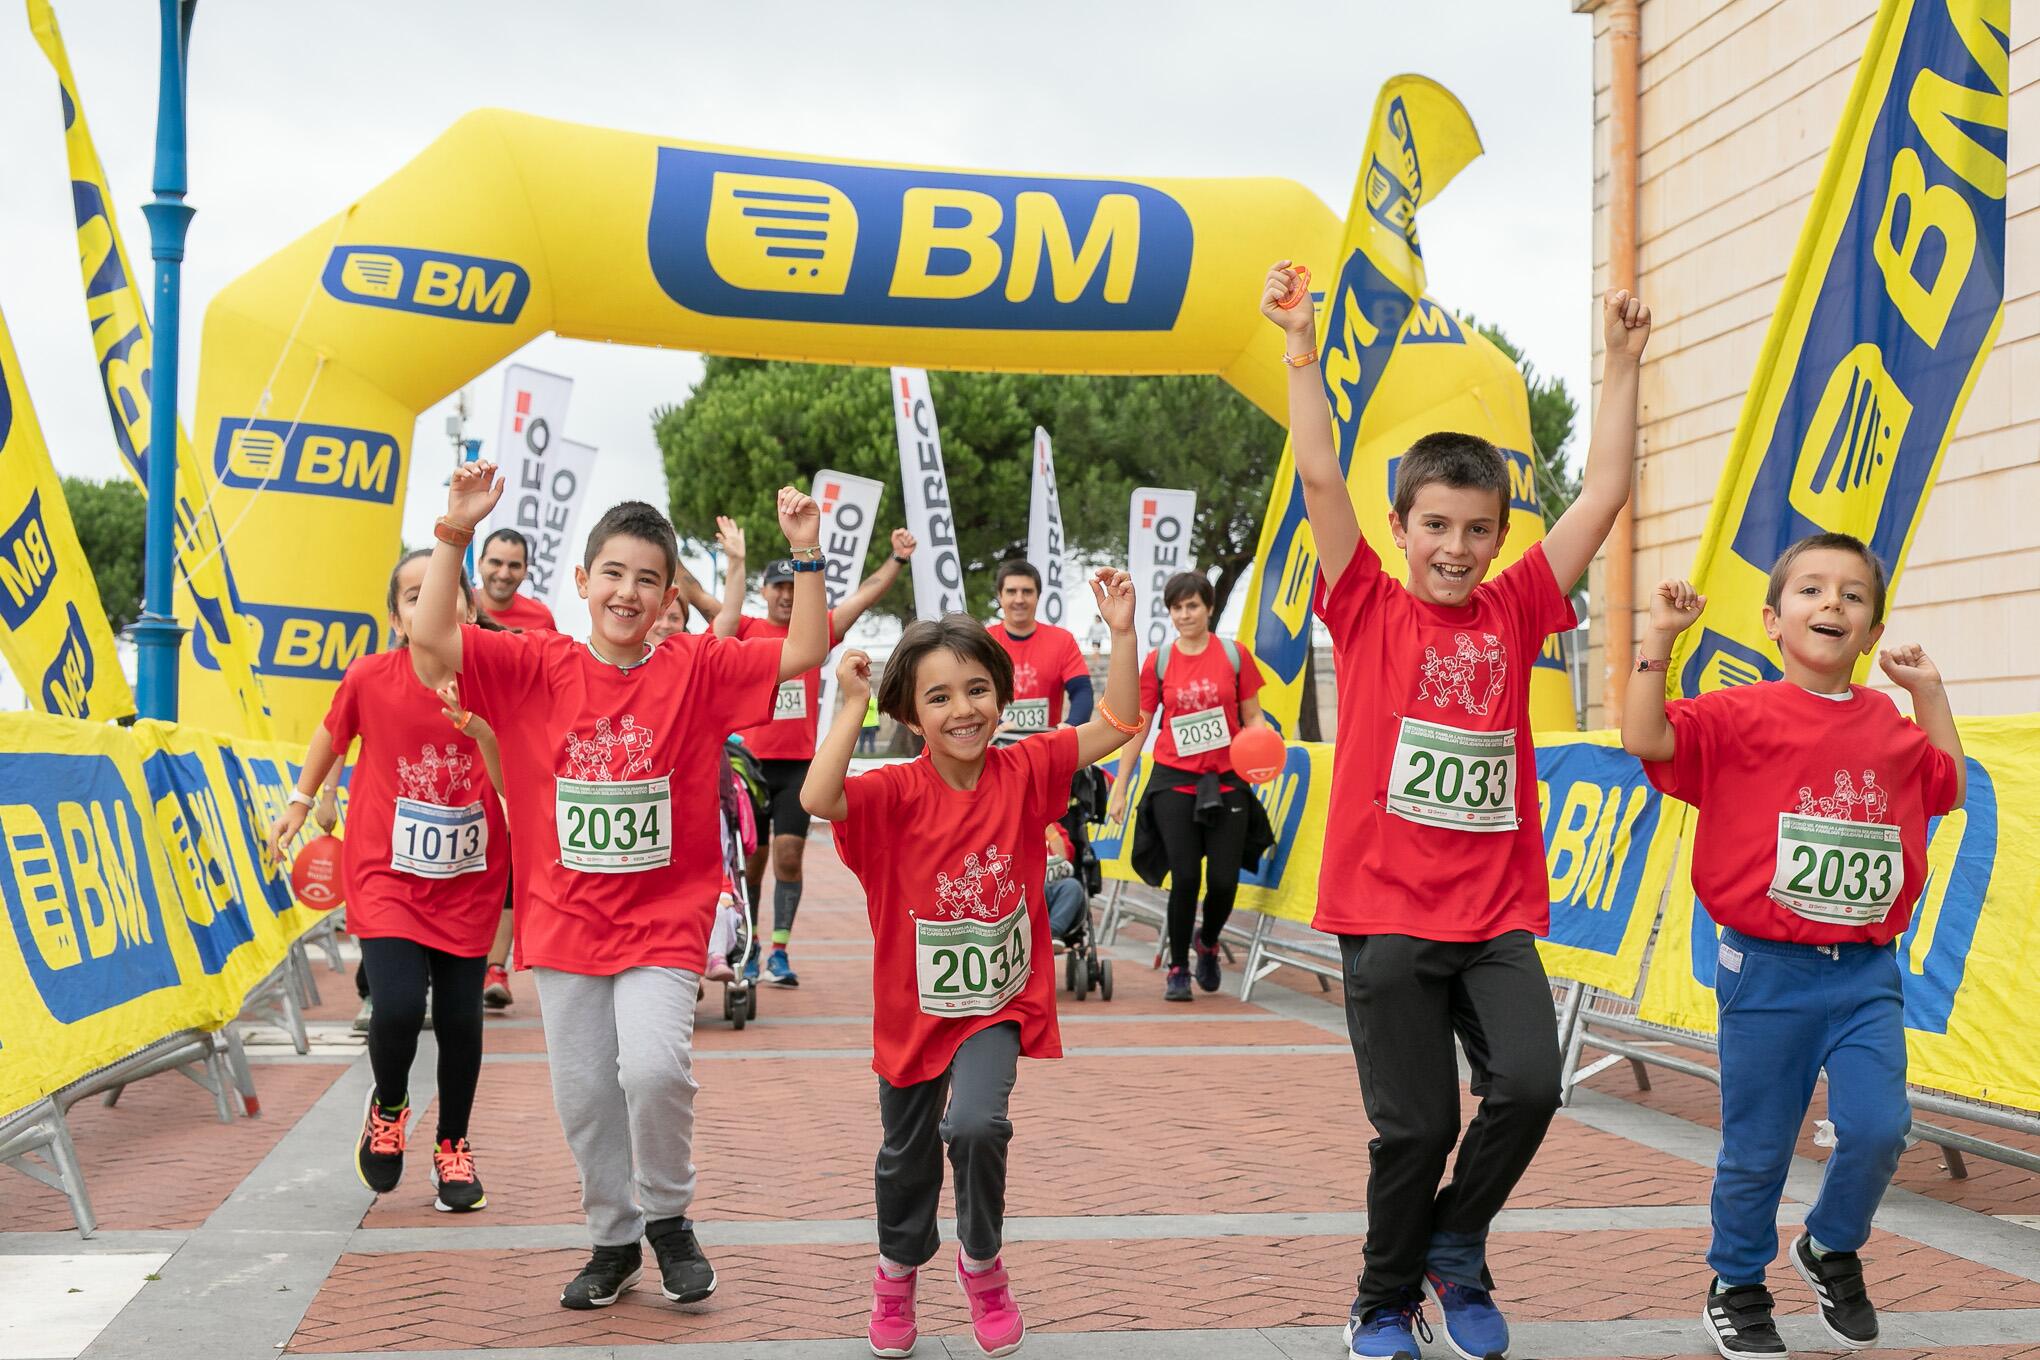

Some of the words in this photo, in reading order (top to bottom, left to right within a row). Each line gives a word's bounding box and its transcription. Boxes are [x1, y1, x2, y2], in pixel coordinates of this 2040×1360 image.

[888, 187, 1141, 304] BM
[413, 259, 518, 315] BM
[296, 435, 392, 494] BM
[273, 617, 367, 671] BM
[1007, 709, 1045, 727] 2033
[1179, 720, 1223, 745] 2033
[1404, 751, 1507, 807] 2033
[406, 823, 479, 860] 1013
[568, 805, 660, 850] 2034
[1547, 781, 1647, 912] BM
[58, 799, 153, 960] BM
[1787, 845, 1892, 901] 2033
[932, 927, 1025, 993] 2034
